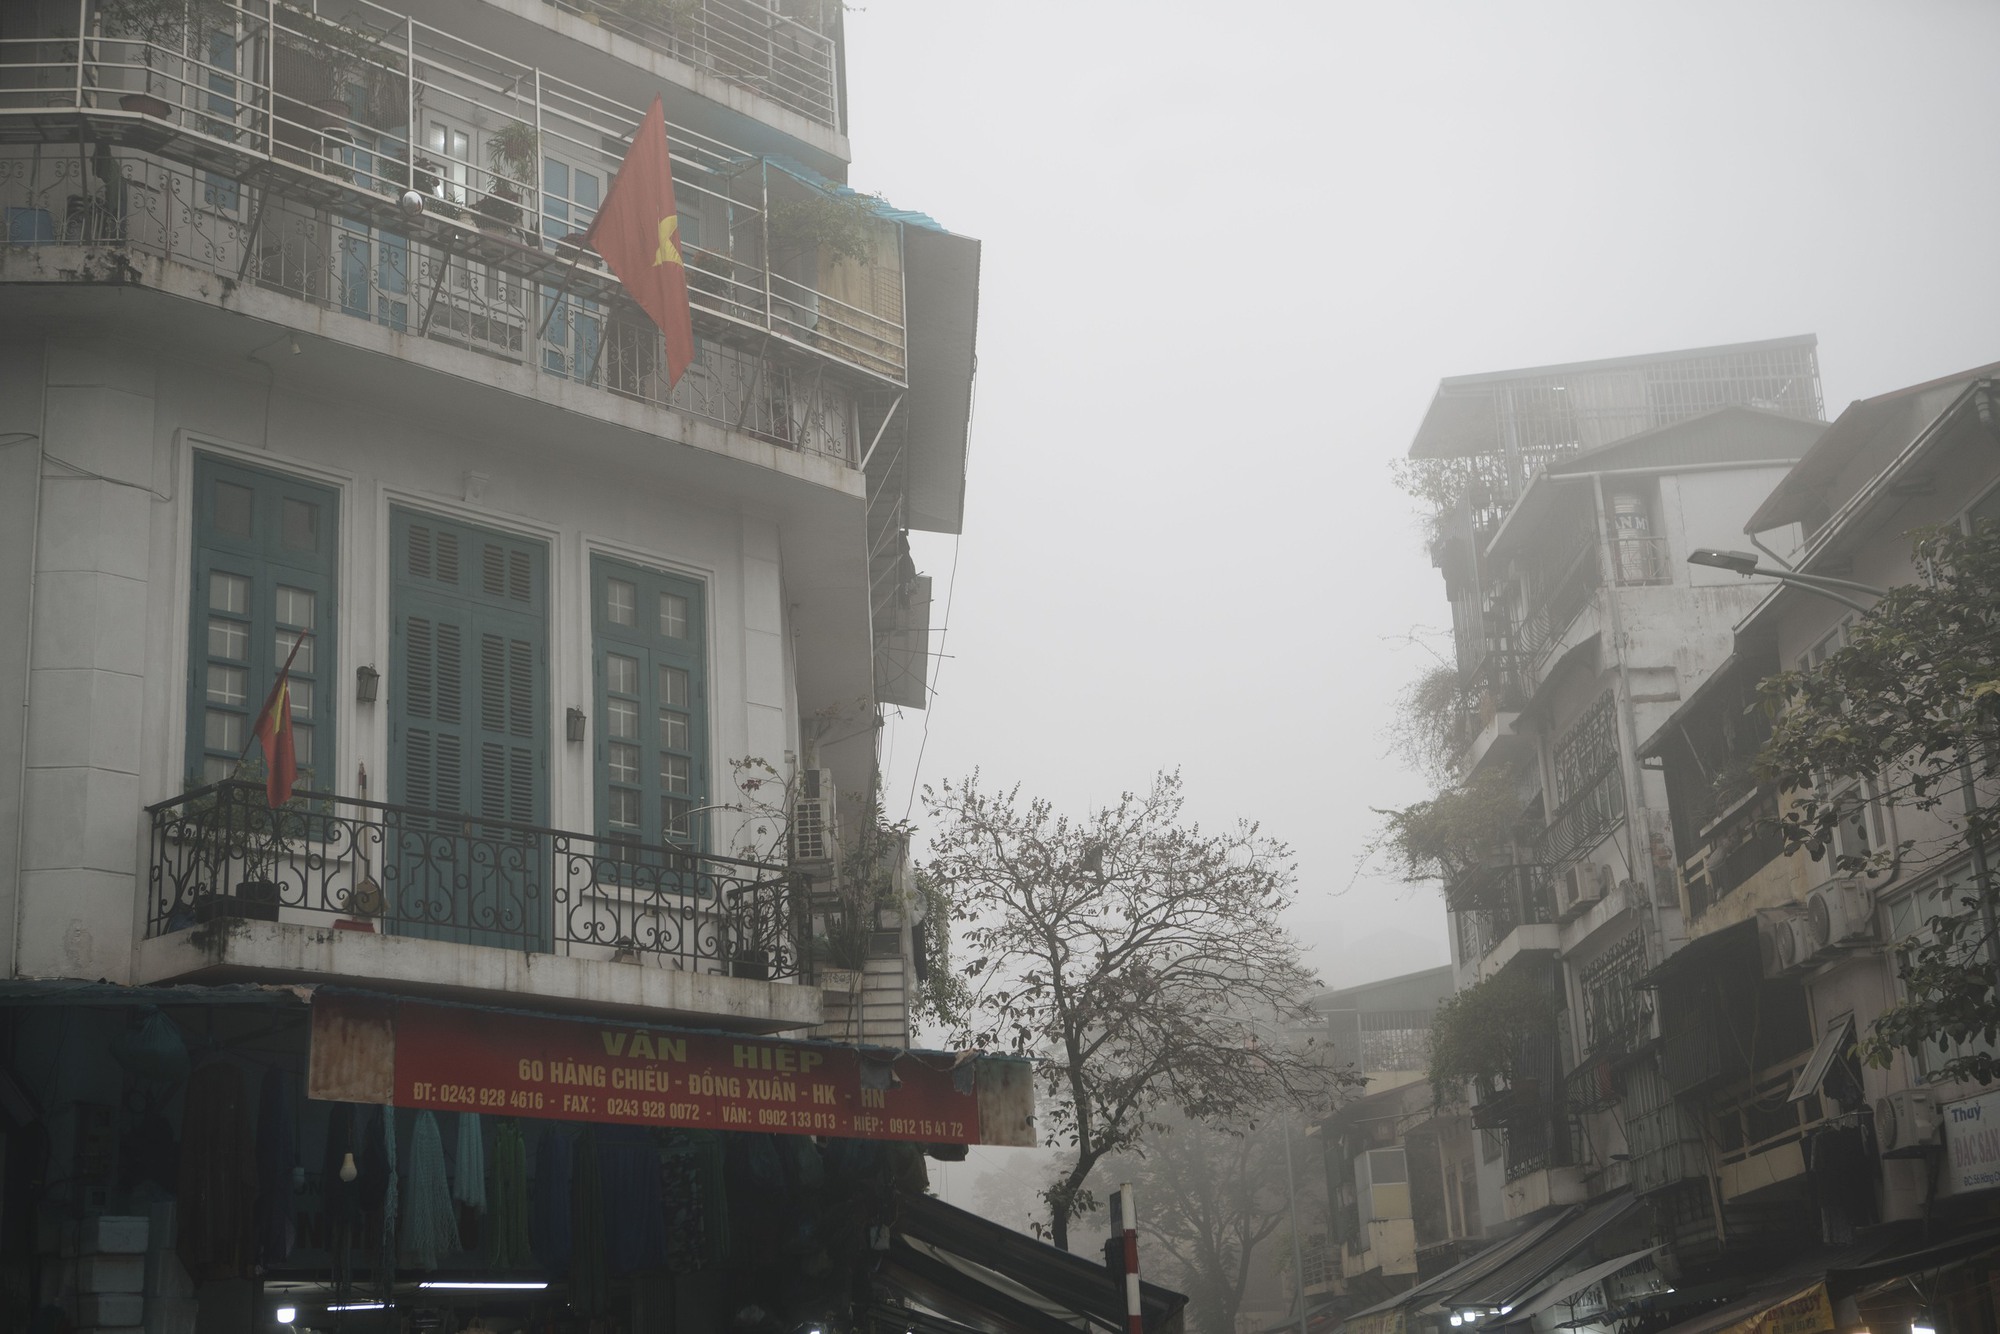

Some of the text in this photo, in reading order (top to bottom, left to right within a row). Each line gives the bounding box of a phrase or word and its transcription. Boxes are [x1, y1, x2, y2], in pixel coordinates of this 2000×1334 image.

[601, 1029, 824, 1077] VÂN HIỆP
[518, 1058, 544, 1083] 60
[550, 1057, 606, 1090] HÀNG
[611, 1064, 669, 1094] CHIẾU
[688, 1070, 741, 1098] ĐỒNG
[746, 1076, 797, 1103] XUÂN
[812, 1084, 837, 1106] HK
[860, 1086, 886, 1109] HN
[413, 1081, 437, 1102] ĐT:
[440, 1084, 476, 1106] 0243
[480, 1087, 507, 1108] 928
[509, 1090, 544, 1110] 4616
[563, 1094, 596, 1114] FAX:
[607, 1097, 639, 1118] 0243
[642, 1100, 667, 1120] 928
[669, 1103, 701, 1124] 0072
[722, 1103, 752, 1126] VÂN:
[758, 1108, 788, 1129] 0902
[790, 1111, 812, 1129] 133
[814, 1113, 837, 1131] 013
[853, 1113, 884, 1136] HIỆP:
[889, 1118, 917, 1136] 0912
[919, 1121, 933, 1137] 15
[934, 1122, 947, 1137] 41
[950, 1122, 965, 1139] 72
